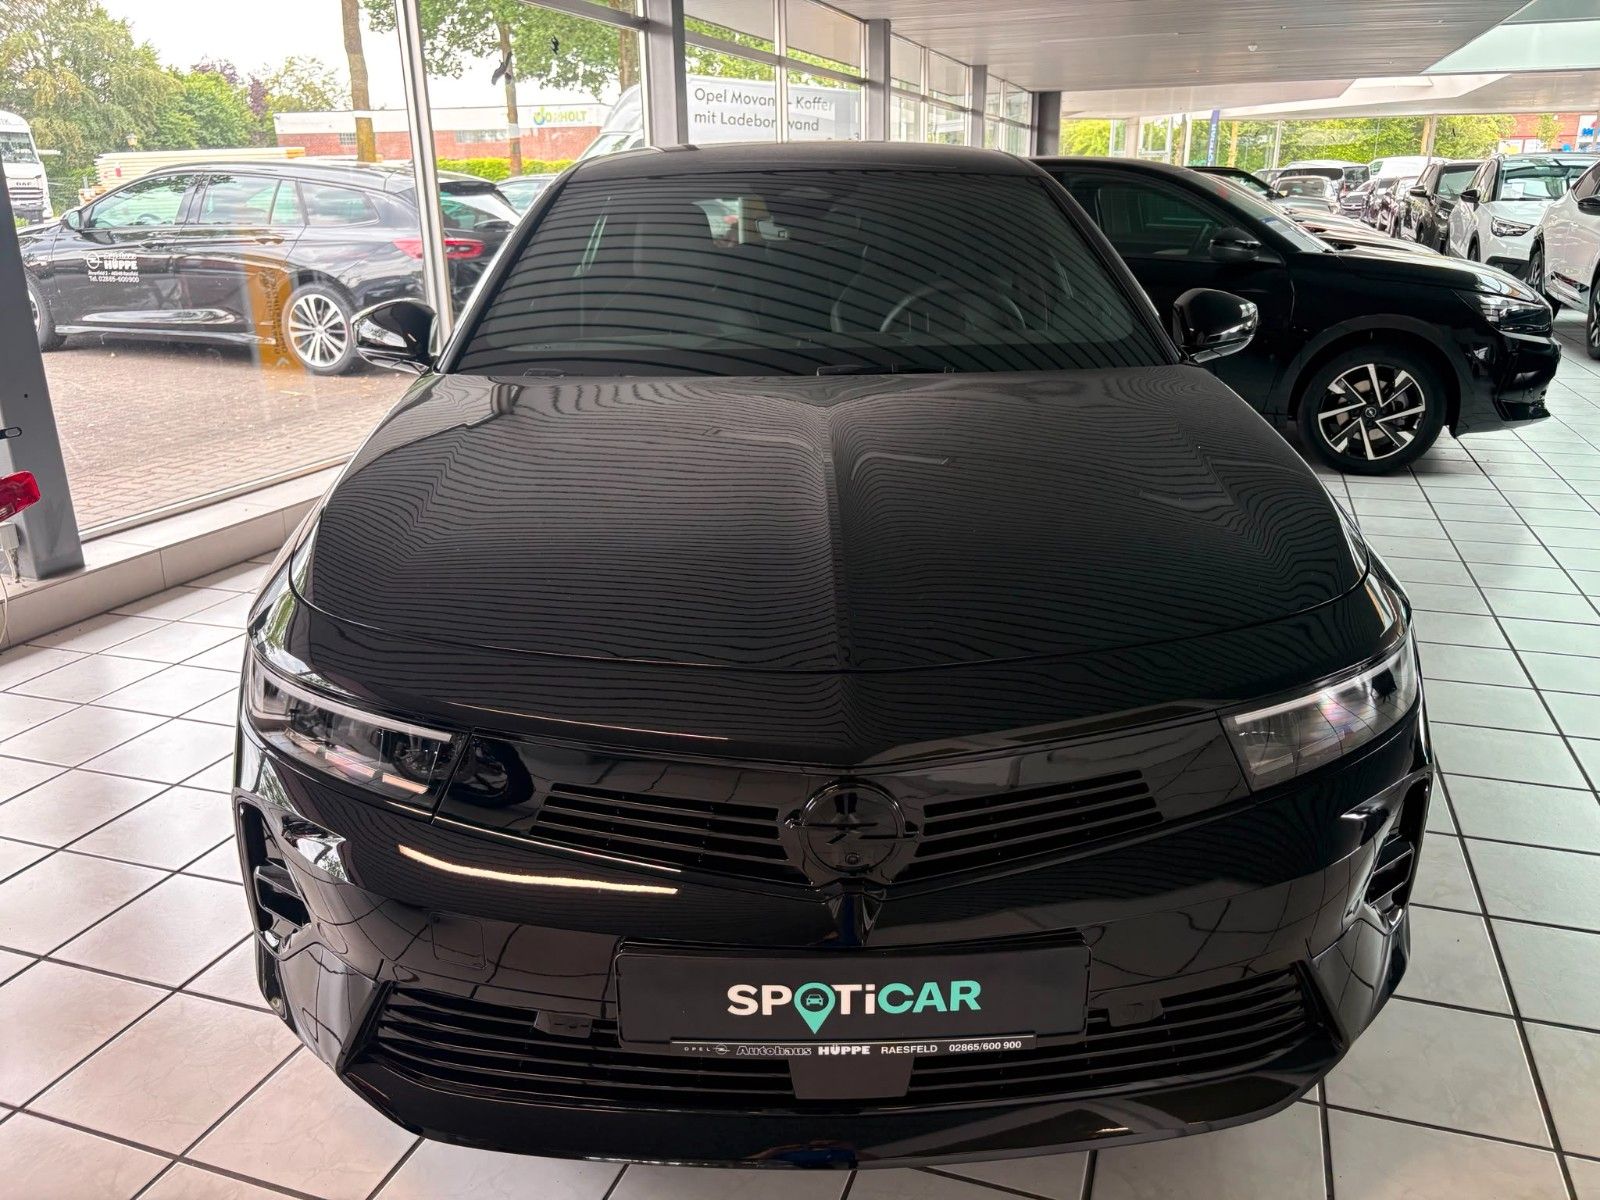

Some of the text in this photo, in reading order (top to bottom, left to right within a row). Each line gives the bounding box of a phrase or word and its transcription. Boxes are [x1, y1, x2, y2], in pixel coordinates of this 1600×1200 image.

[694, 87, 727, 105] Opel
[730, 91, 775, 107] Movan
[796, 95, 833, 112] Koffer
[694, 110, 820, 132] mit Ladeborwand
[103, 258, 138, 270] HÜPPE
[735, 1045, 812, 1056] Autohaus
[817, 1043, 871, 1056] HÜPPE
[880, 1044, 938, 1055] RAESFELD
[949, 1042, 1001, 1052] 02865/600
[1003, 1040, 1022, 1050] 900
